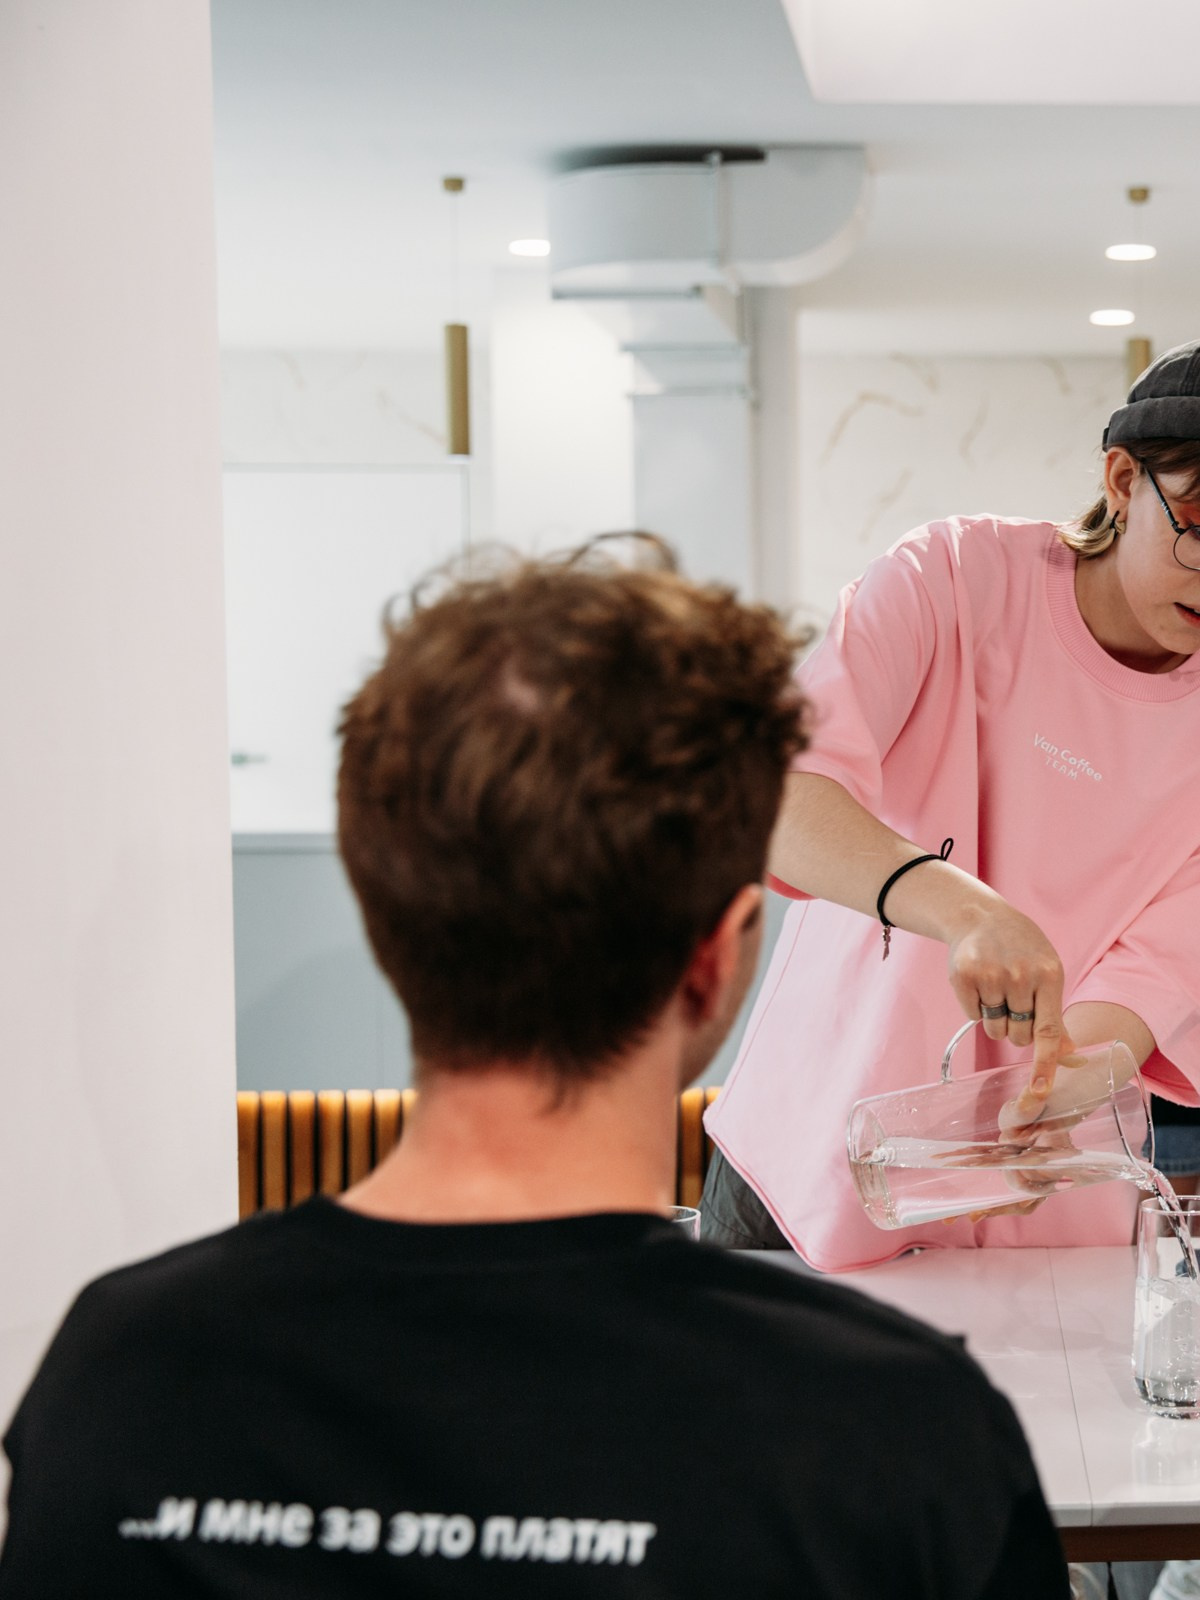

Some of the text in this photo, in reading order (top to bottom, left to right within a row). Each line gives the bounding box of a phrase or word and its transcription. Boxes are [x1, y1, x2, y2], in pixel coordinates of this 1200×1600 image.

[1046, 756, 1078, 780] TEAM
[199, 1499, 315, 1547] мне
[318, 1506, 381, 1553] за
[386, 1511, 476, 1559] это
[480, 1515, 657, 1565] платят
